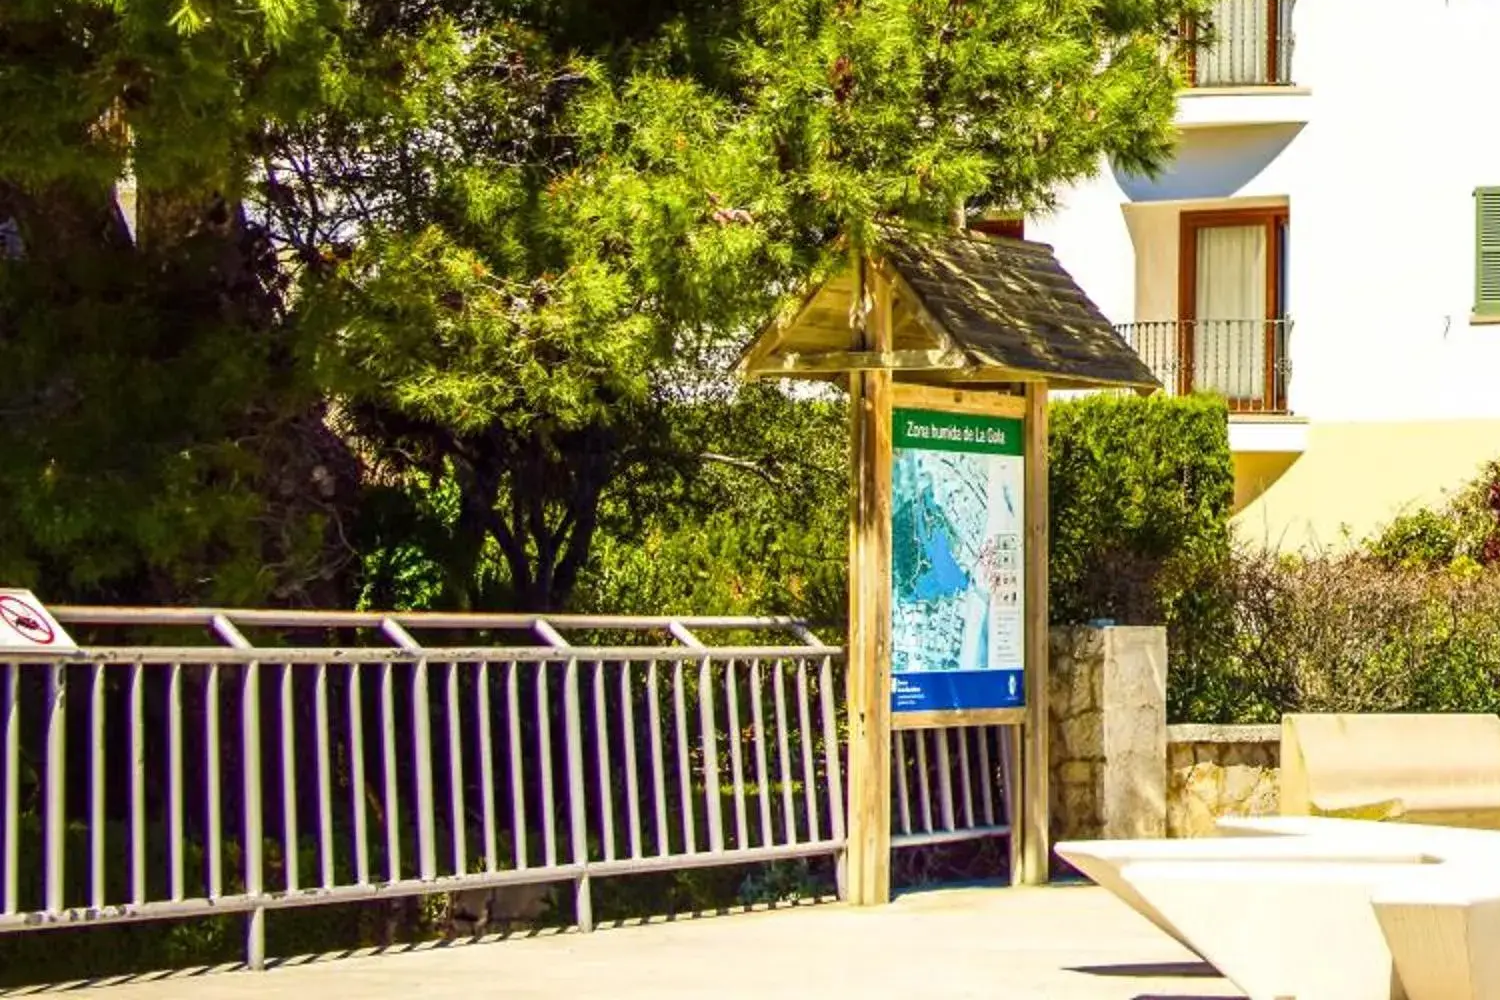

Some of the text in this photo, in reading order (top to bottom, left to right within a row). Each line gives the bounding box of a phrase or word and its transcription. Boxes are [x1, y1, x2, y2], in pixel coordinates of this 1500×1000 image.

[907, 420, 930, 438] Zona
[963, 426, 974, 441] de
[975, 426, 985, 443] La
